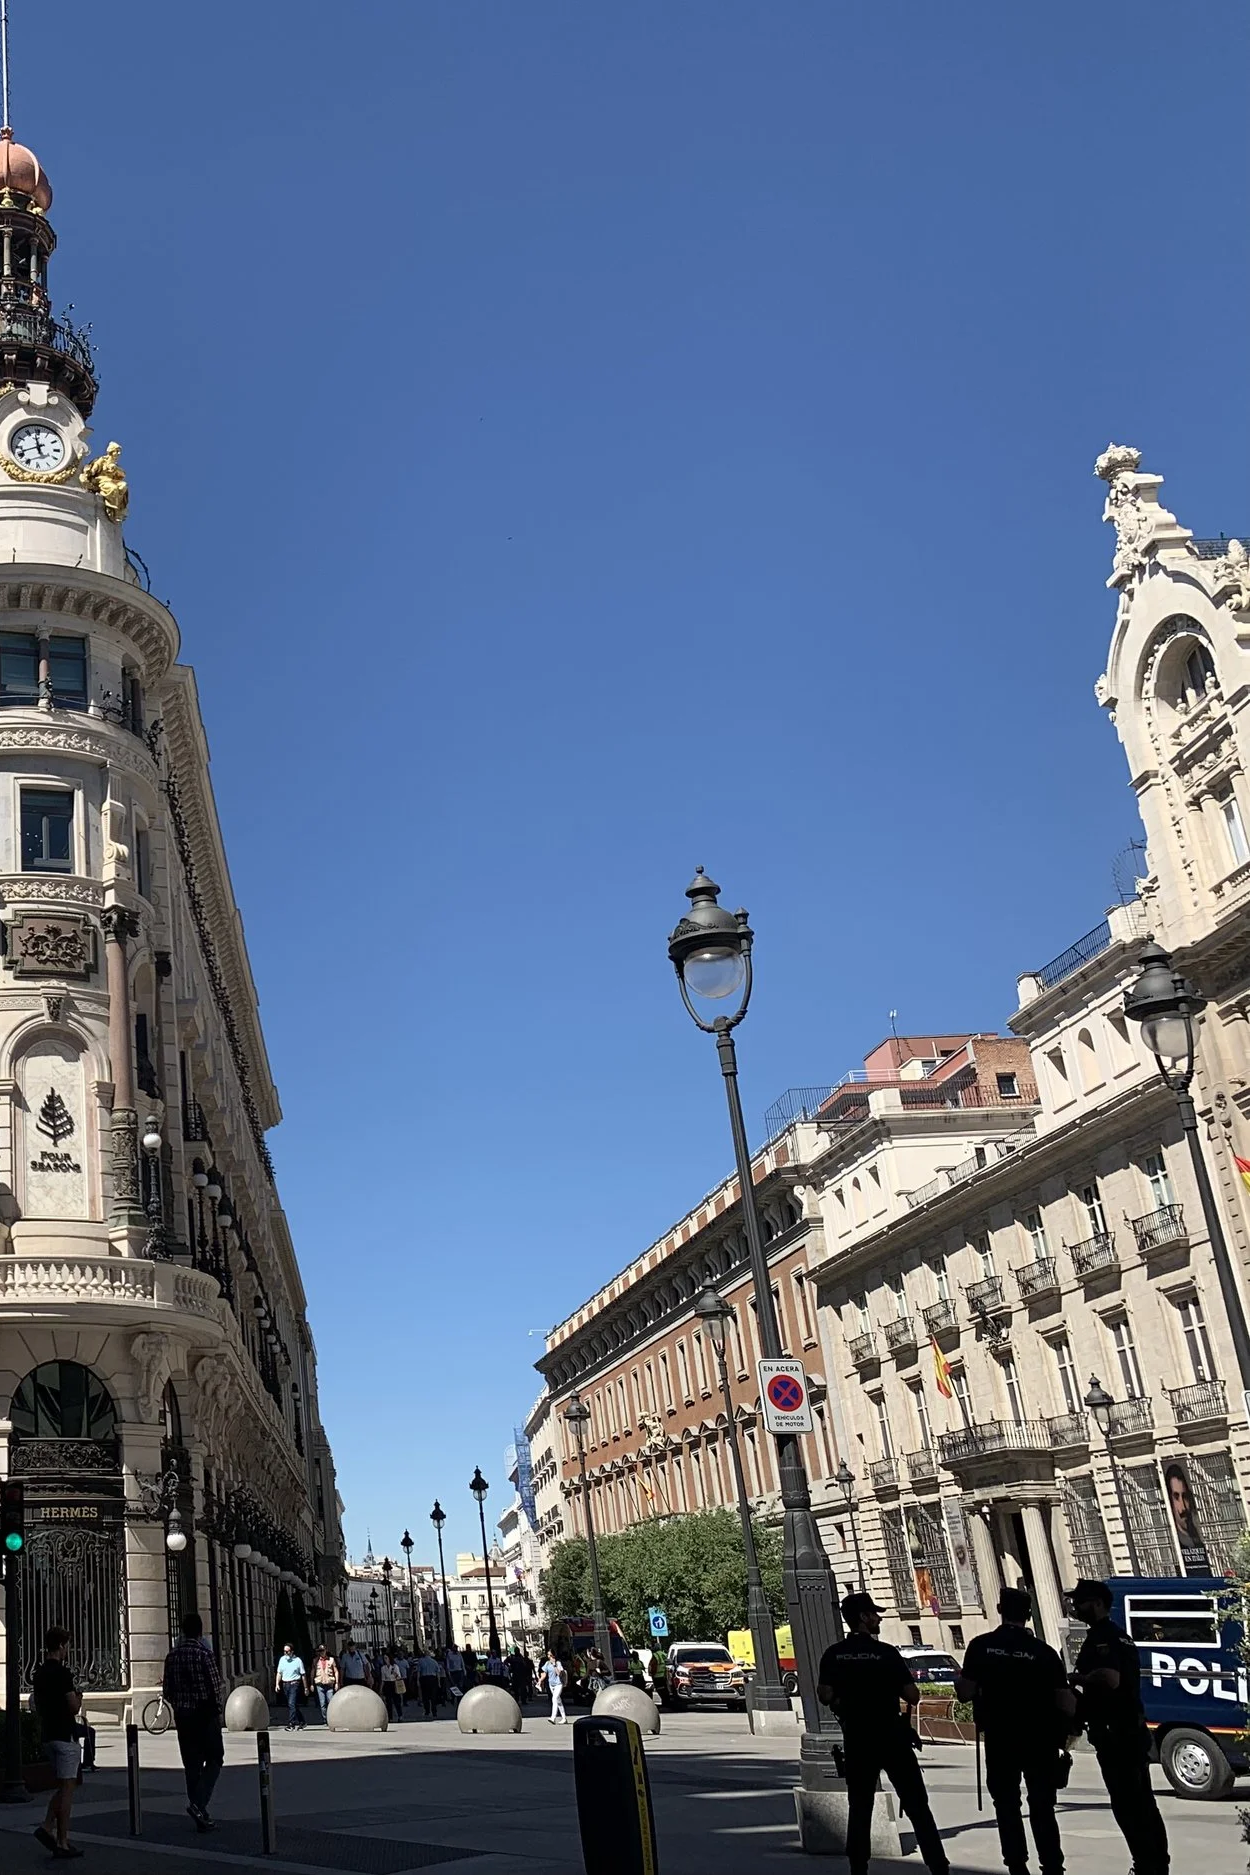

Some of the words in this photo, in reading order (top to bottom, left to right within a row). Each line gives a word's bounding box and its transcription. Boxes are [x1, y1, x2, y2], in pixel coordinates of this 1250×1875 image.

[40, 1151, 72, 1162] FOUR
[30, 1160, 82, 1174] SEASONS
[986, 1647, 1031, 1660] POLCIA
